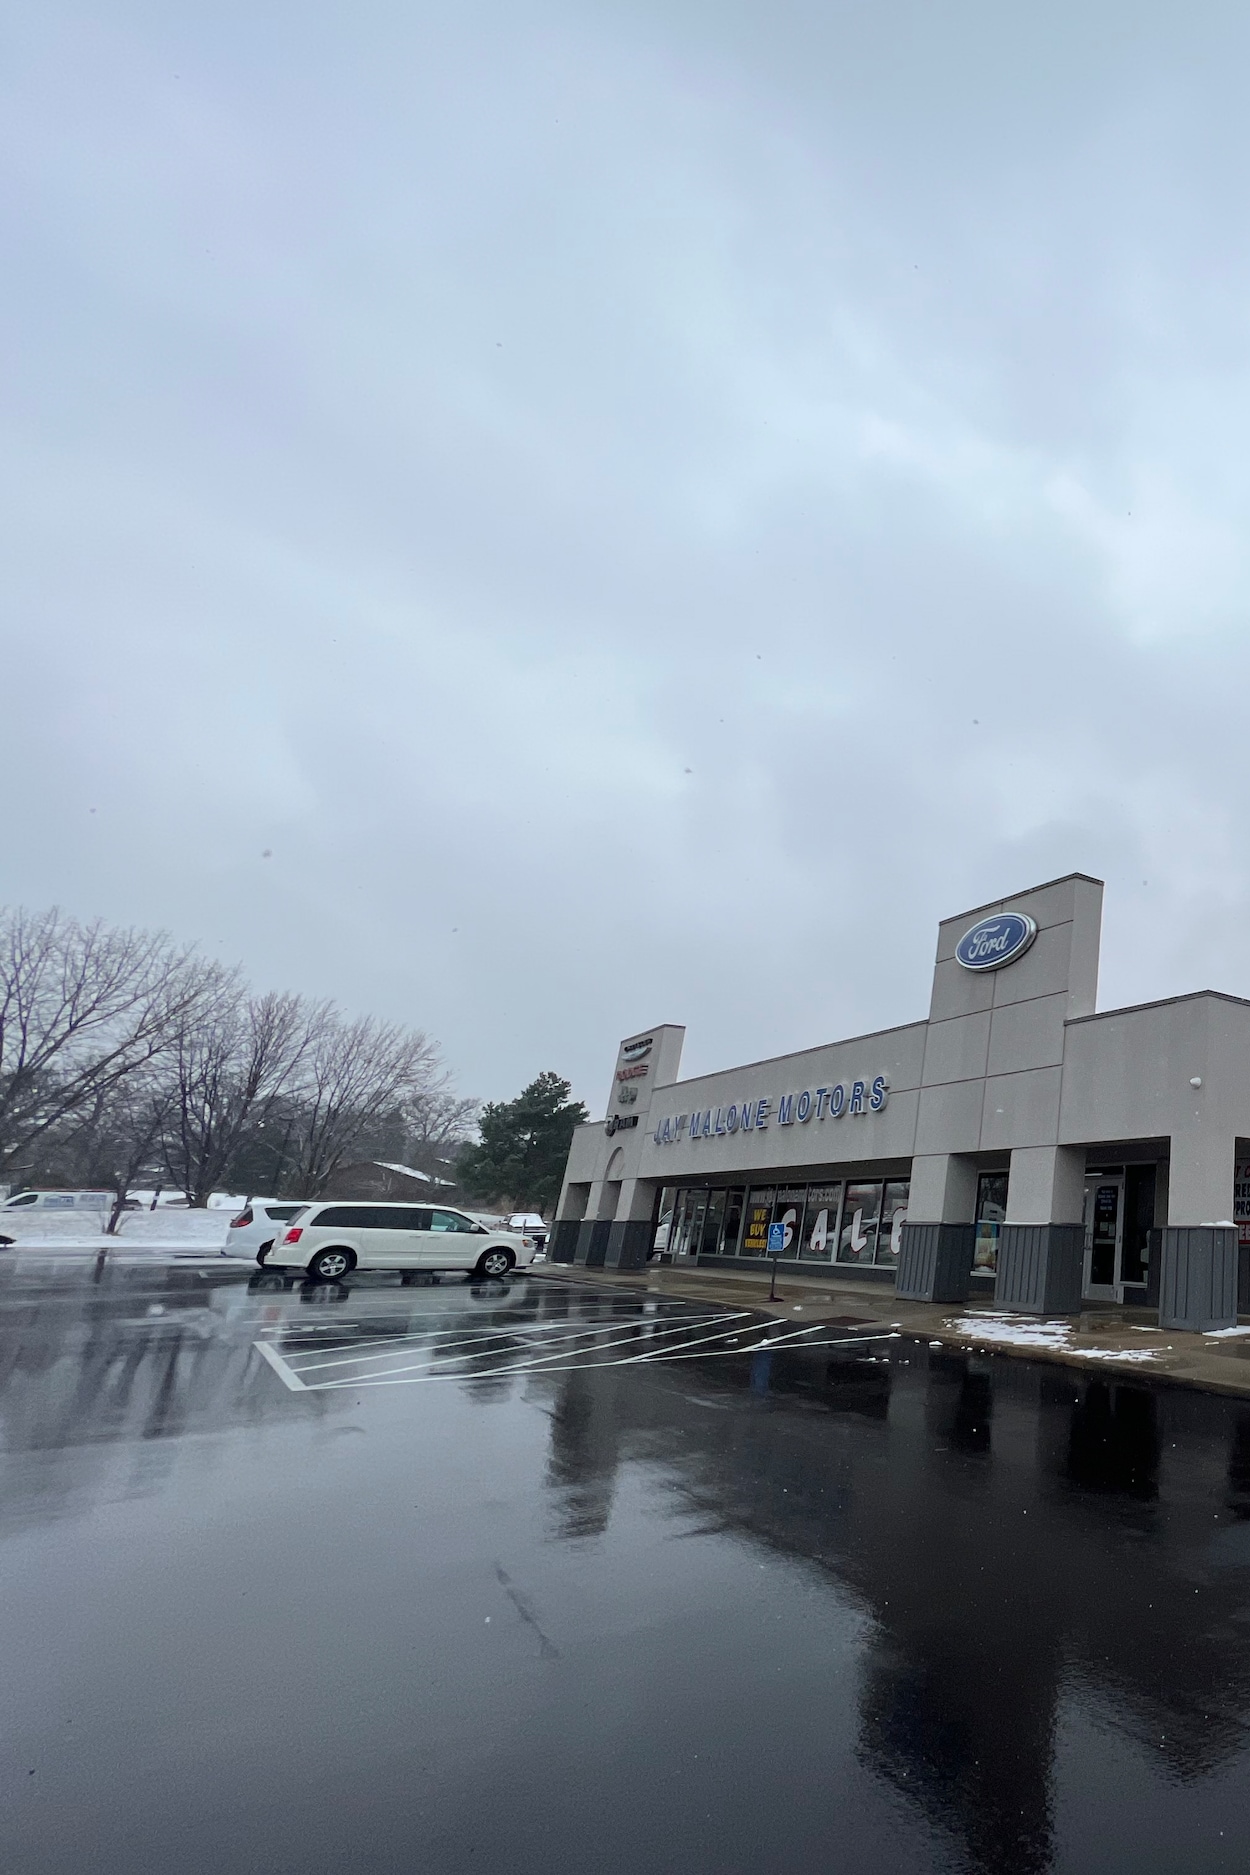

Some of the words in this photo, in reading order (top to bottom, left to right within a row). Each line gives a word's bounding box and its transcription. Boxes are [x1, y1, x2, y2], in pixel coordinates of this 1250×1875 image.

[967, 925, 1011, 959] Ford
[654, 1115, 681, 1145] JAY
[689, 1099, 769, 1138] MALONE
[778, 1075, 886, 1124] MOTORS
